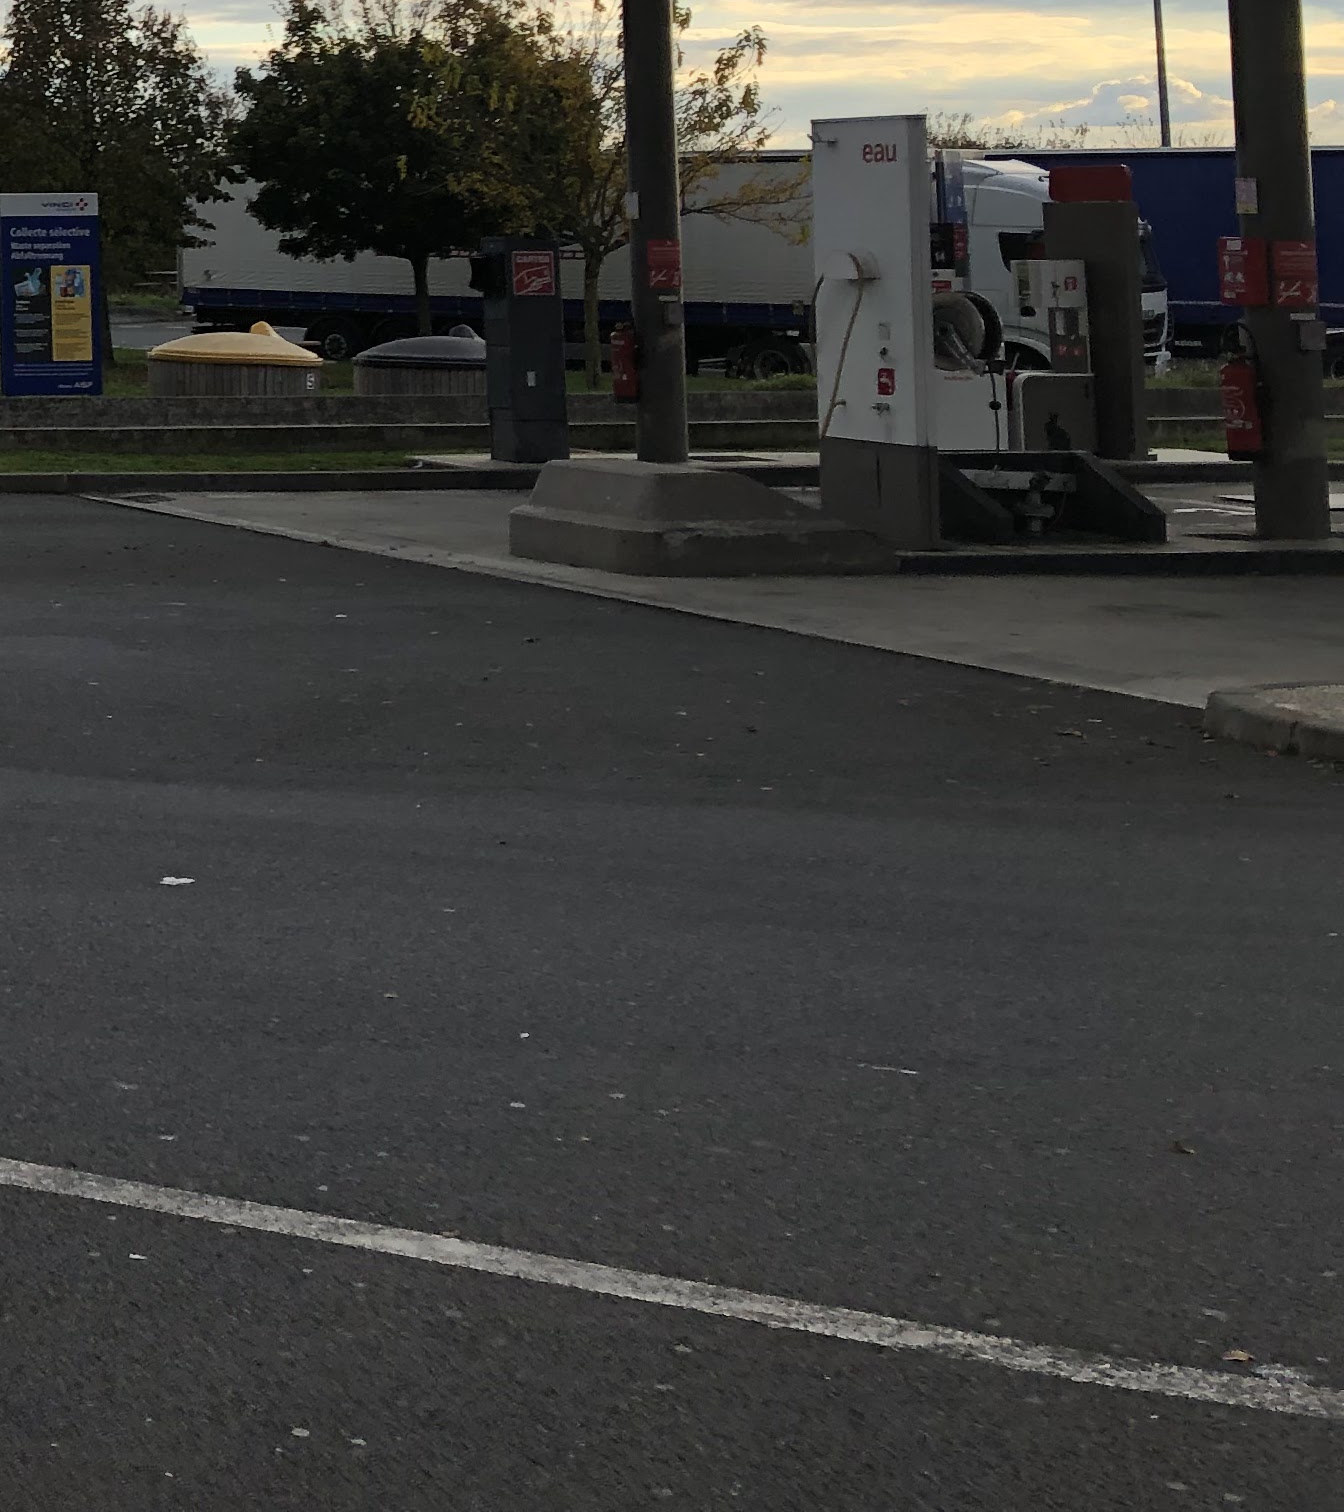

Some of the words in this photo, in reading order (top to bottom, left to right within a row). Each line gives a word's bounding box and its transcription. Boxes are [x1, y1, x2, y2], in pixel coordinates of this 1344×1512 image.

[862, 143, 897, 163] eau
[9, 226, 47, 237] Collecte
[48, 226, 91, 237] sélective
